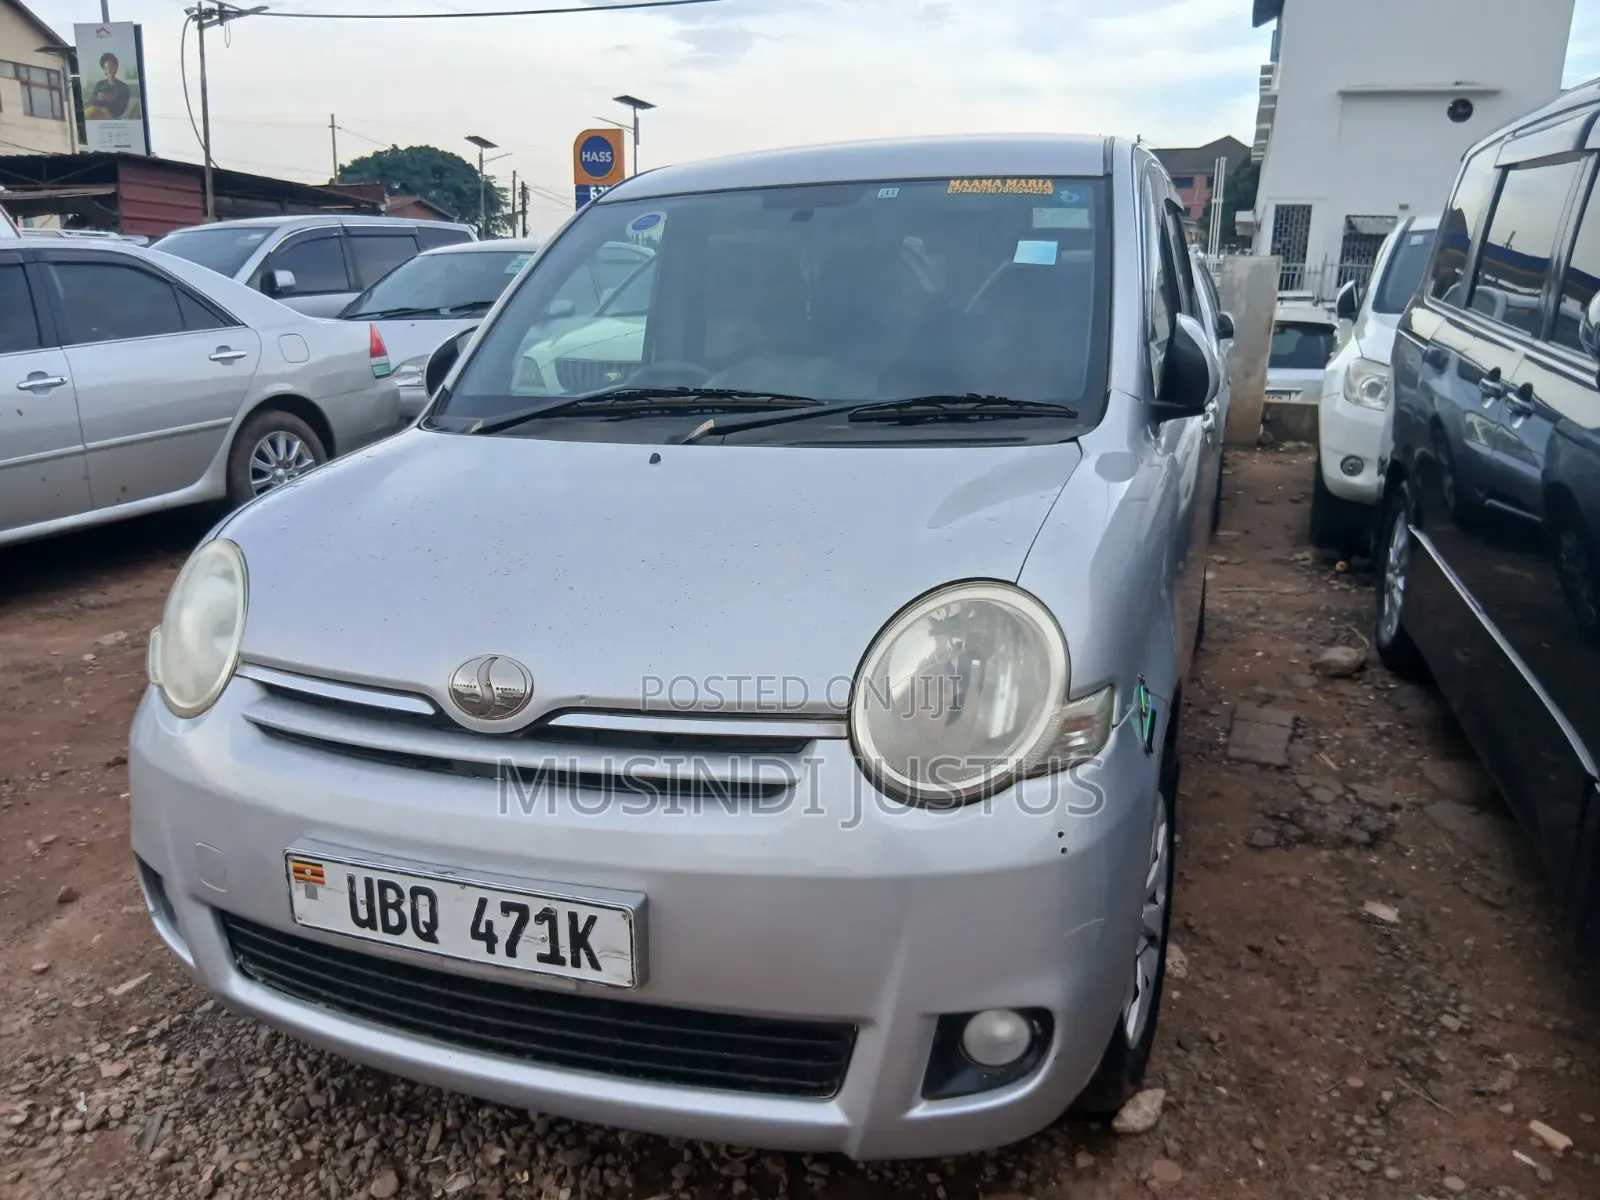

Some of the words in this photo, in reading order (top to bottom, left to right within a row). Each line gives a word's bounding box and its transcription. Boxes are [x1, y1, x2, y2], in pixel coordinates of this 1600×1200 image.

[582, 151, 612, 163] HASS
[949, 179, 1002, 188] MAAMA
[1006, 179, 1054, 188] MARIA
[346, 872, 441, 945] UBQ
[470, 896, 603, 973] 471K
